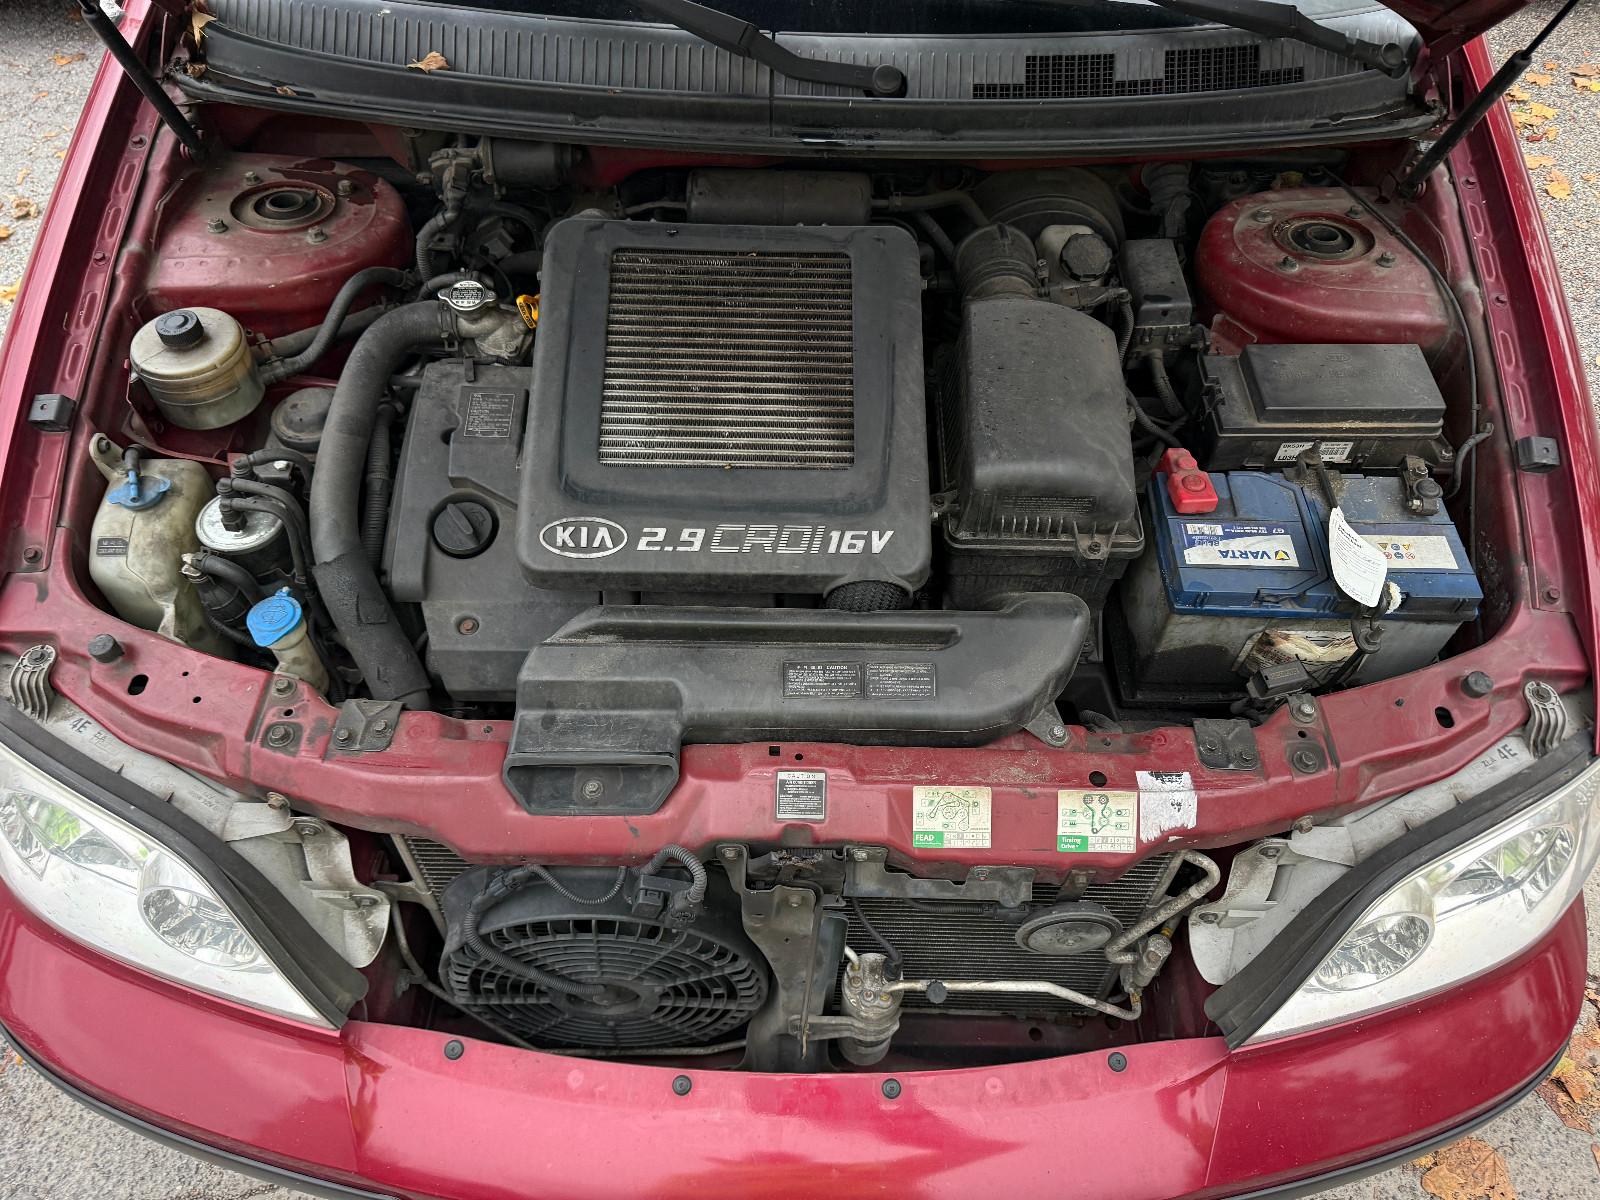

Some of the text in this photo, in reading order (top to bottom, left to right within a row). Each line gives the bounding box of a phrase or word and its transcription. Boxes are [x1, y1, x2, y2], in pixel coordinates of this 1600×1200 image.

[636, 527, 706, 552] 2.9
[710, 524, 827, 554] CRDI
[828, 530, 895, 554] 16V
[1218, 549, 1271, 560] VARTA
[70, 717, 92, 733] 4E
[1497, 743, 1518, 760] 4E
